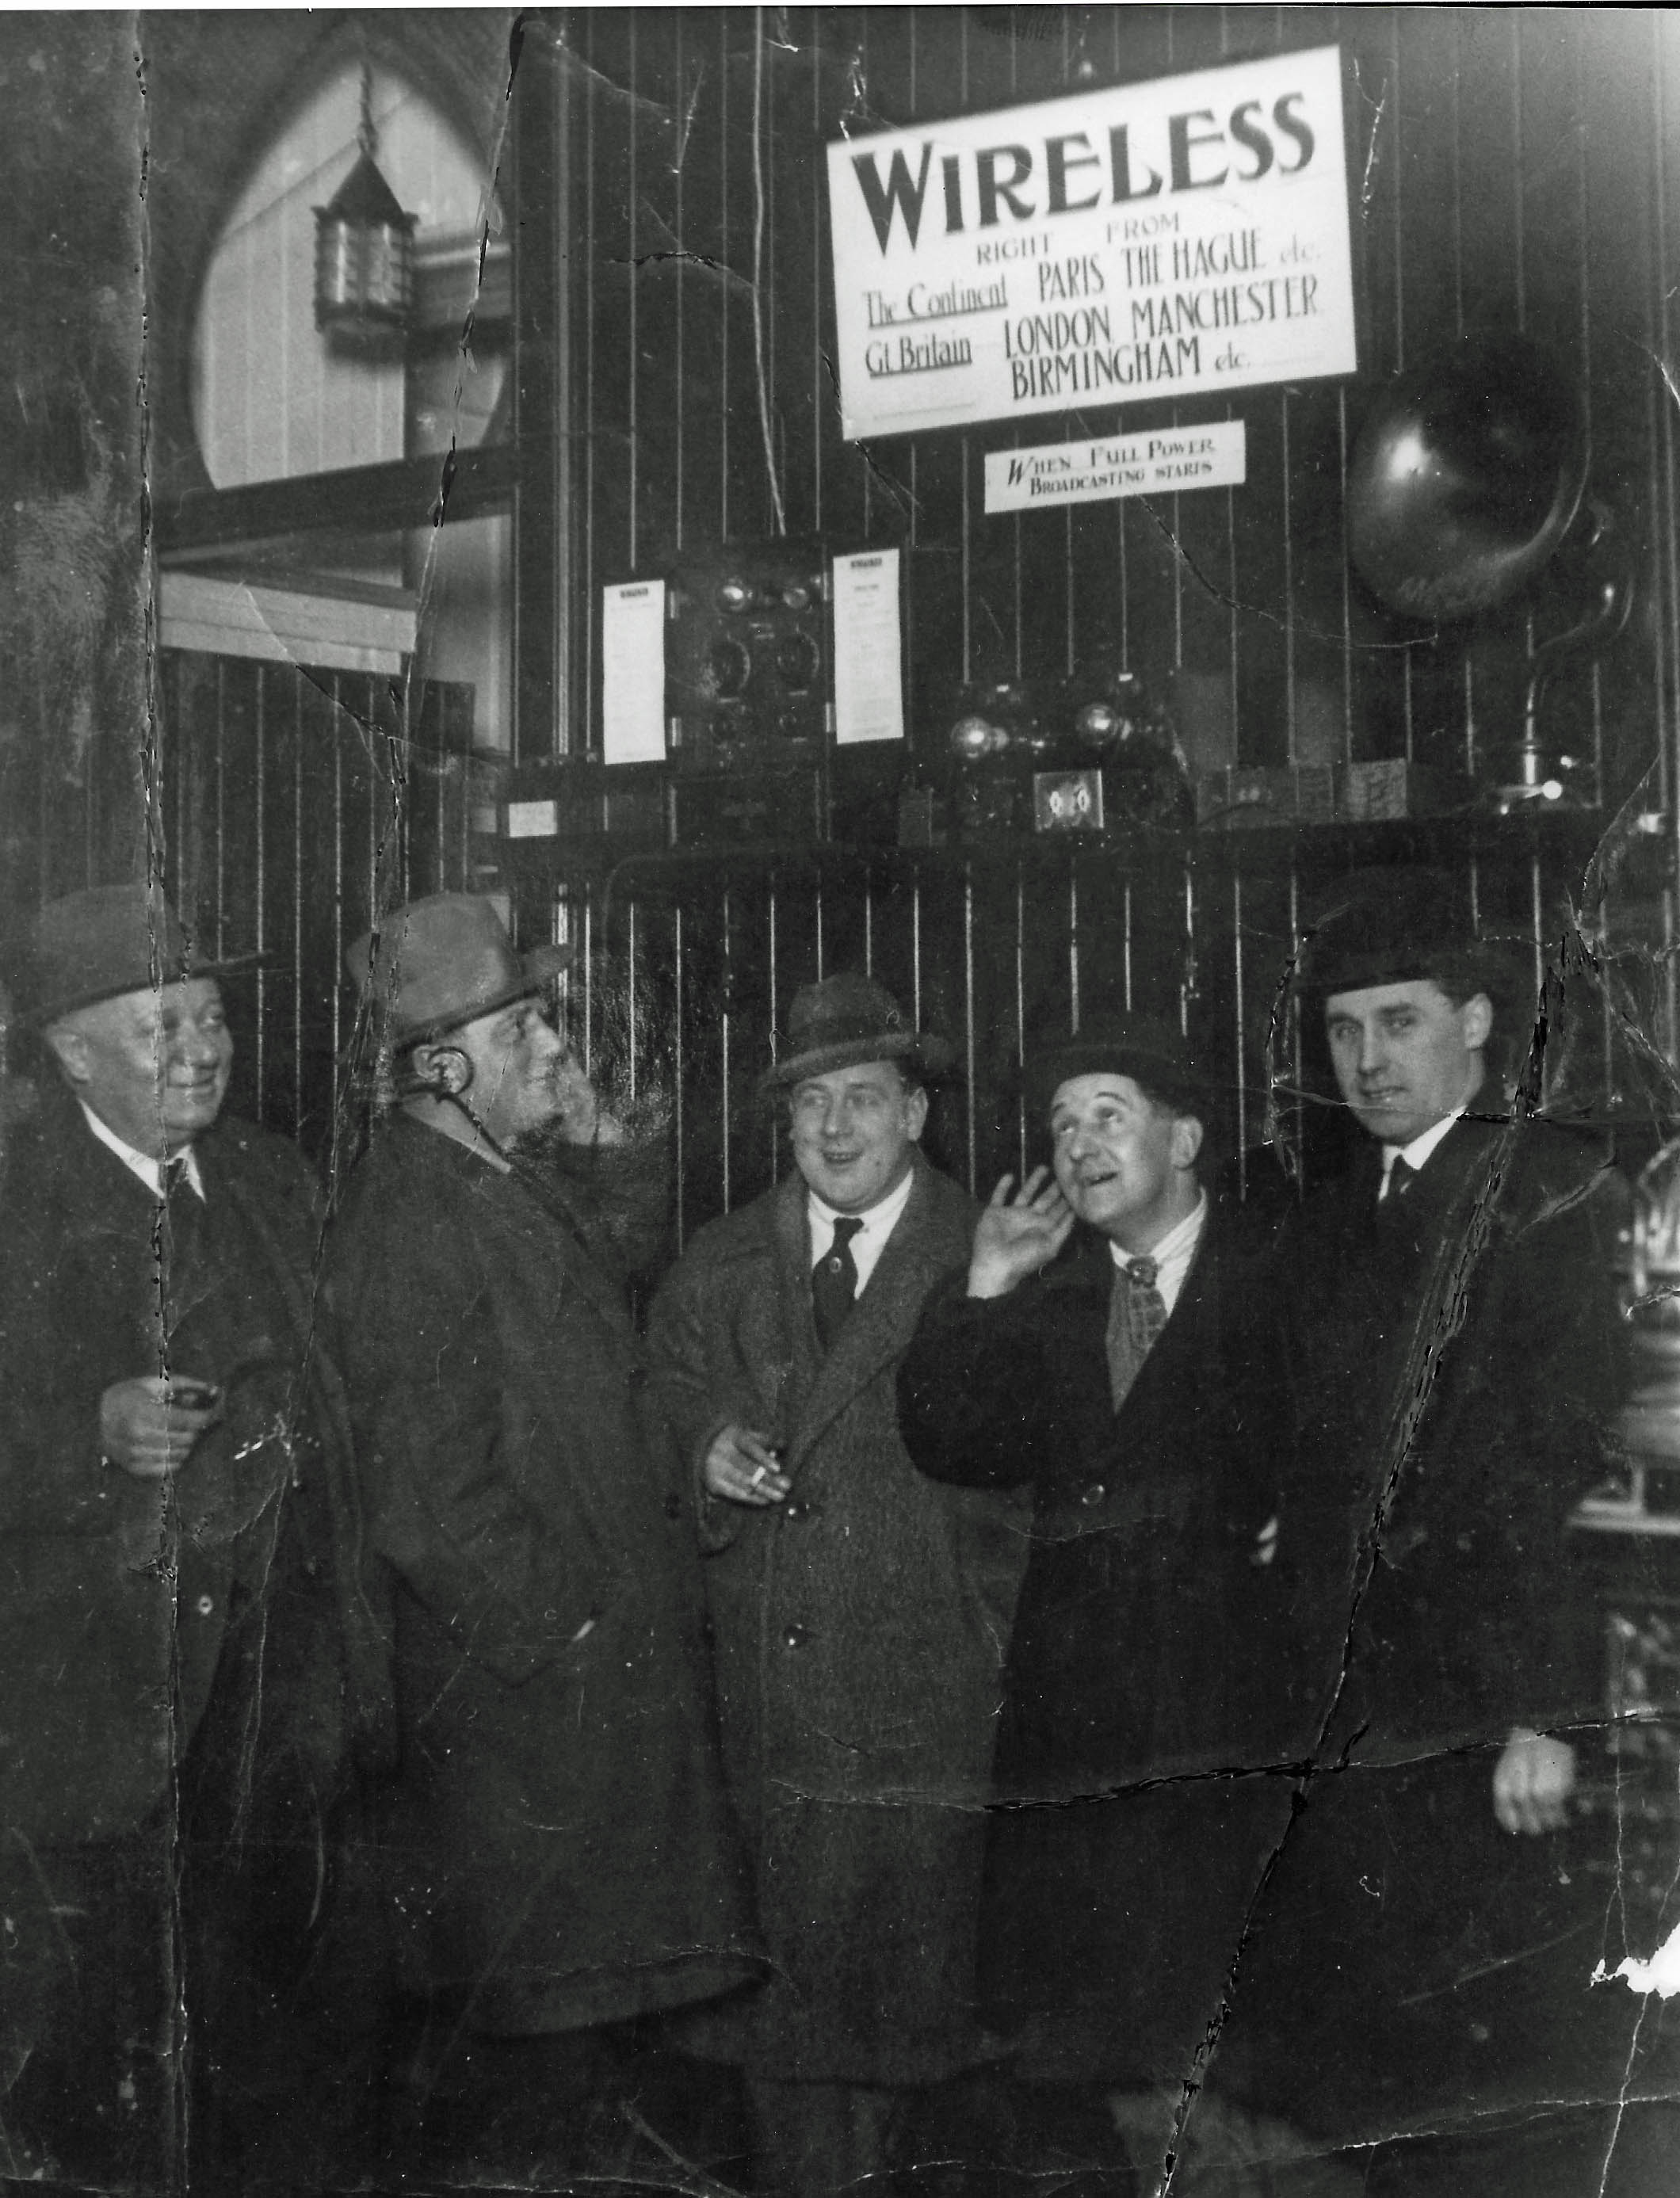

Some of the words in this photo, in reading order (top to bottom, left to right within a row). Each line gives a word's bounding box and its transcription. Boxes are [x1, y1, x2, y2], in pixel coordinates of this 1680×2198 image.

[850, 90, 1316, 258] WIRELESS
[977, 231, 1052, 265] RIGHT
[1106, 212, 1180, 243] FROM
[862, 290, 896, 326] The
[907, 273, 1007, 319] Continent
[1038, 253, 1105, 303] PARIS
[1121, 243, 1164, 288] THE
[1173, 227, 1267, 280] HAGUE
[899, 333, 972, 370] Britain
[1132, 274, 1318, 340] MANCHESTER
[1010, 336, 1201, 401] BIRMINGHAM
[1008, 456, 1071, 487] WHEN
[1090, 445, 1140, 467] FULL
[1148, 438, 1216, 459] POWER
[1030, 468, 1146, 496] BROADCASTING
